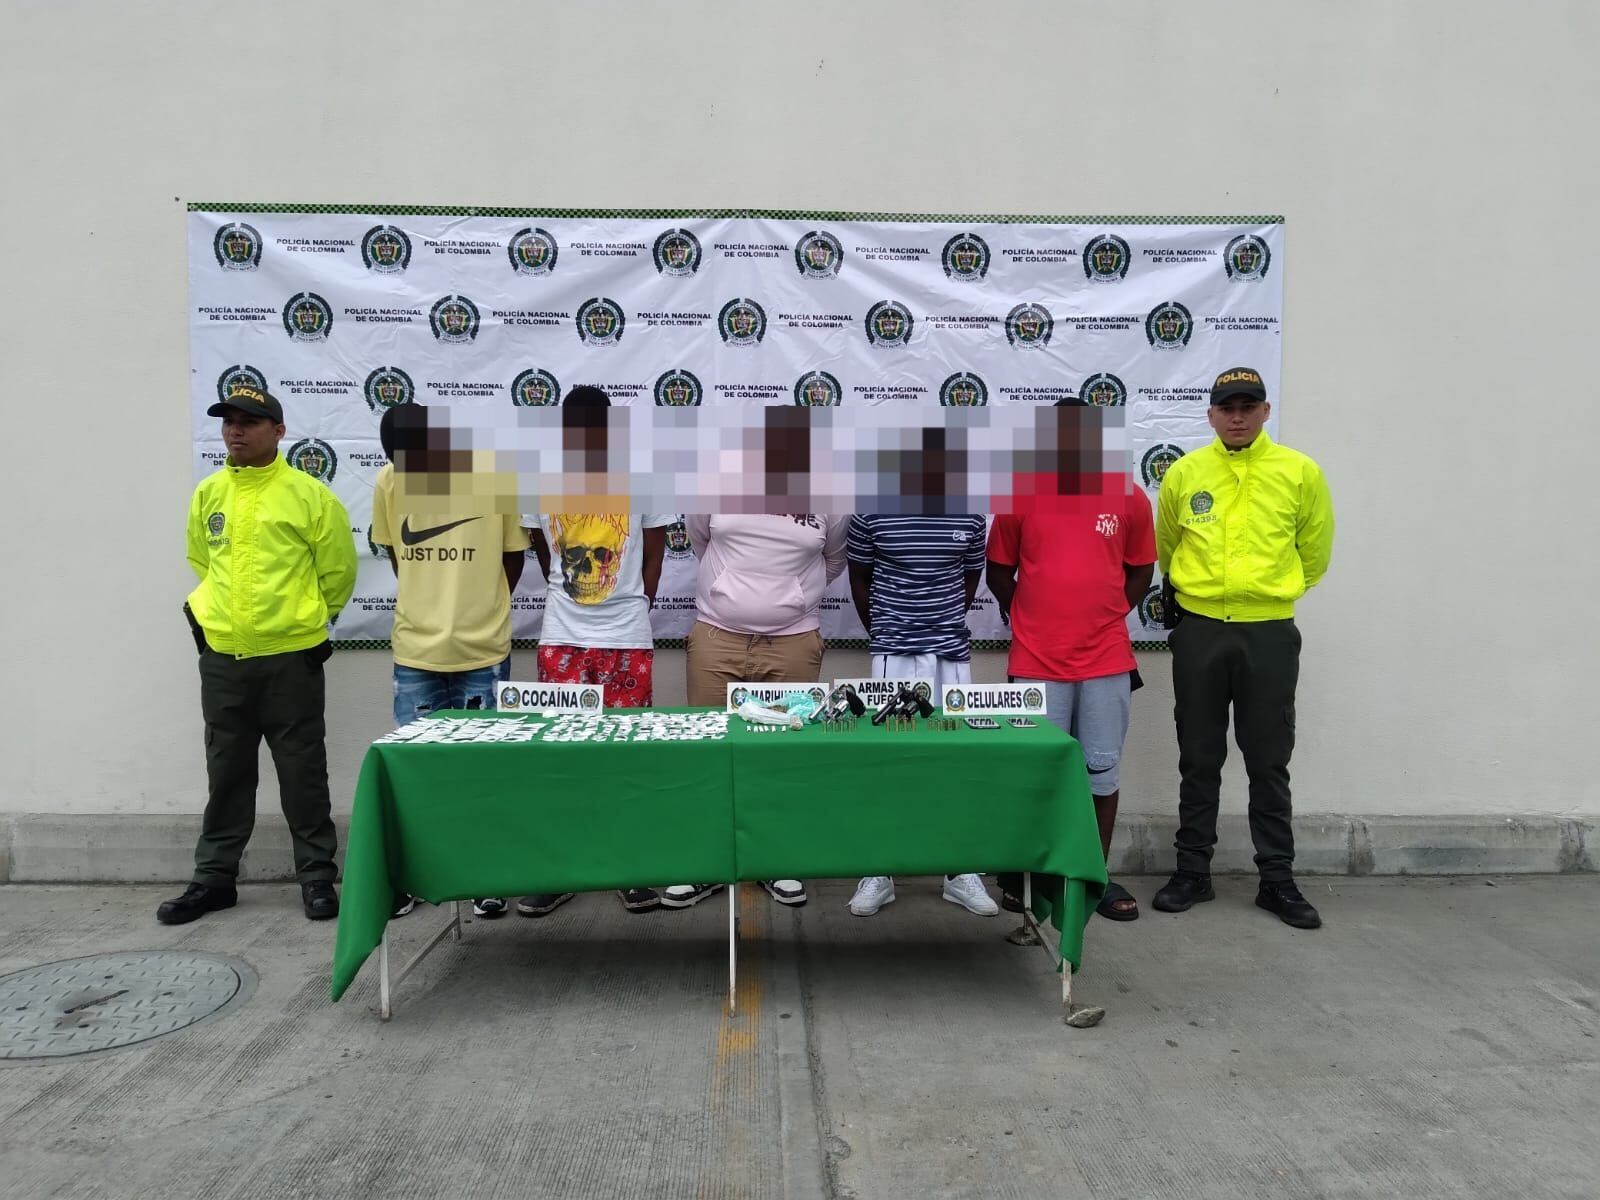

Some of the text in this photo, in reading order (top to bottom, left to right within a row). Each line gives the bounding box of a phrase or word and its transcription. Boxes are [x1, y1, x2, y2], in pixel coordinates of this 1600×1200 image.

[277, 238, 355, 247] POLICÍA NACIONAL
[424, 239, 456, 247] POLICÍA
[301, 246, 344, 254] COLOMBIA
[714, 243, 746, 251] POLICÍA
[1003, 248, 1034, 256] POLICÍA
[345, 307, 377, 315] POLICÍA
[493, 310, 525, 318] POLICÍA
[925, 315, 999, 324] POLICÍA NACIONAL
[1205, 316, 1236, 324] POLICÍA
[281, 379, 313, 387] POLICÍA
[401, 548, 476, 562] JUST DO IT
[858, 682, 895, 694] ARMAS
[521, 686, 579, 709] COCAÍNA
[967, 691, 1022, 708] CELULARES
